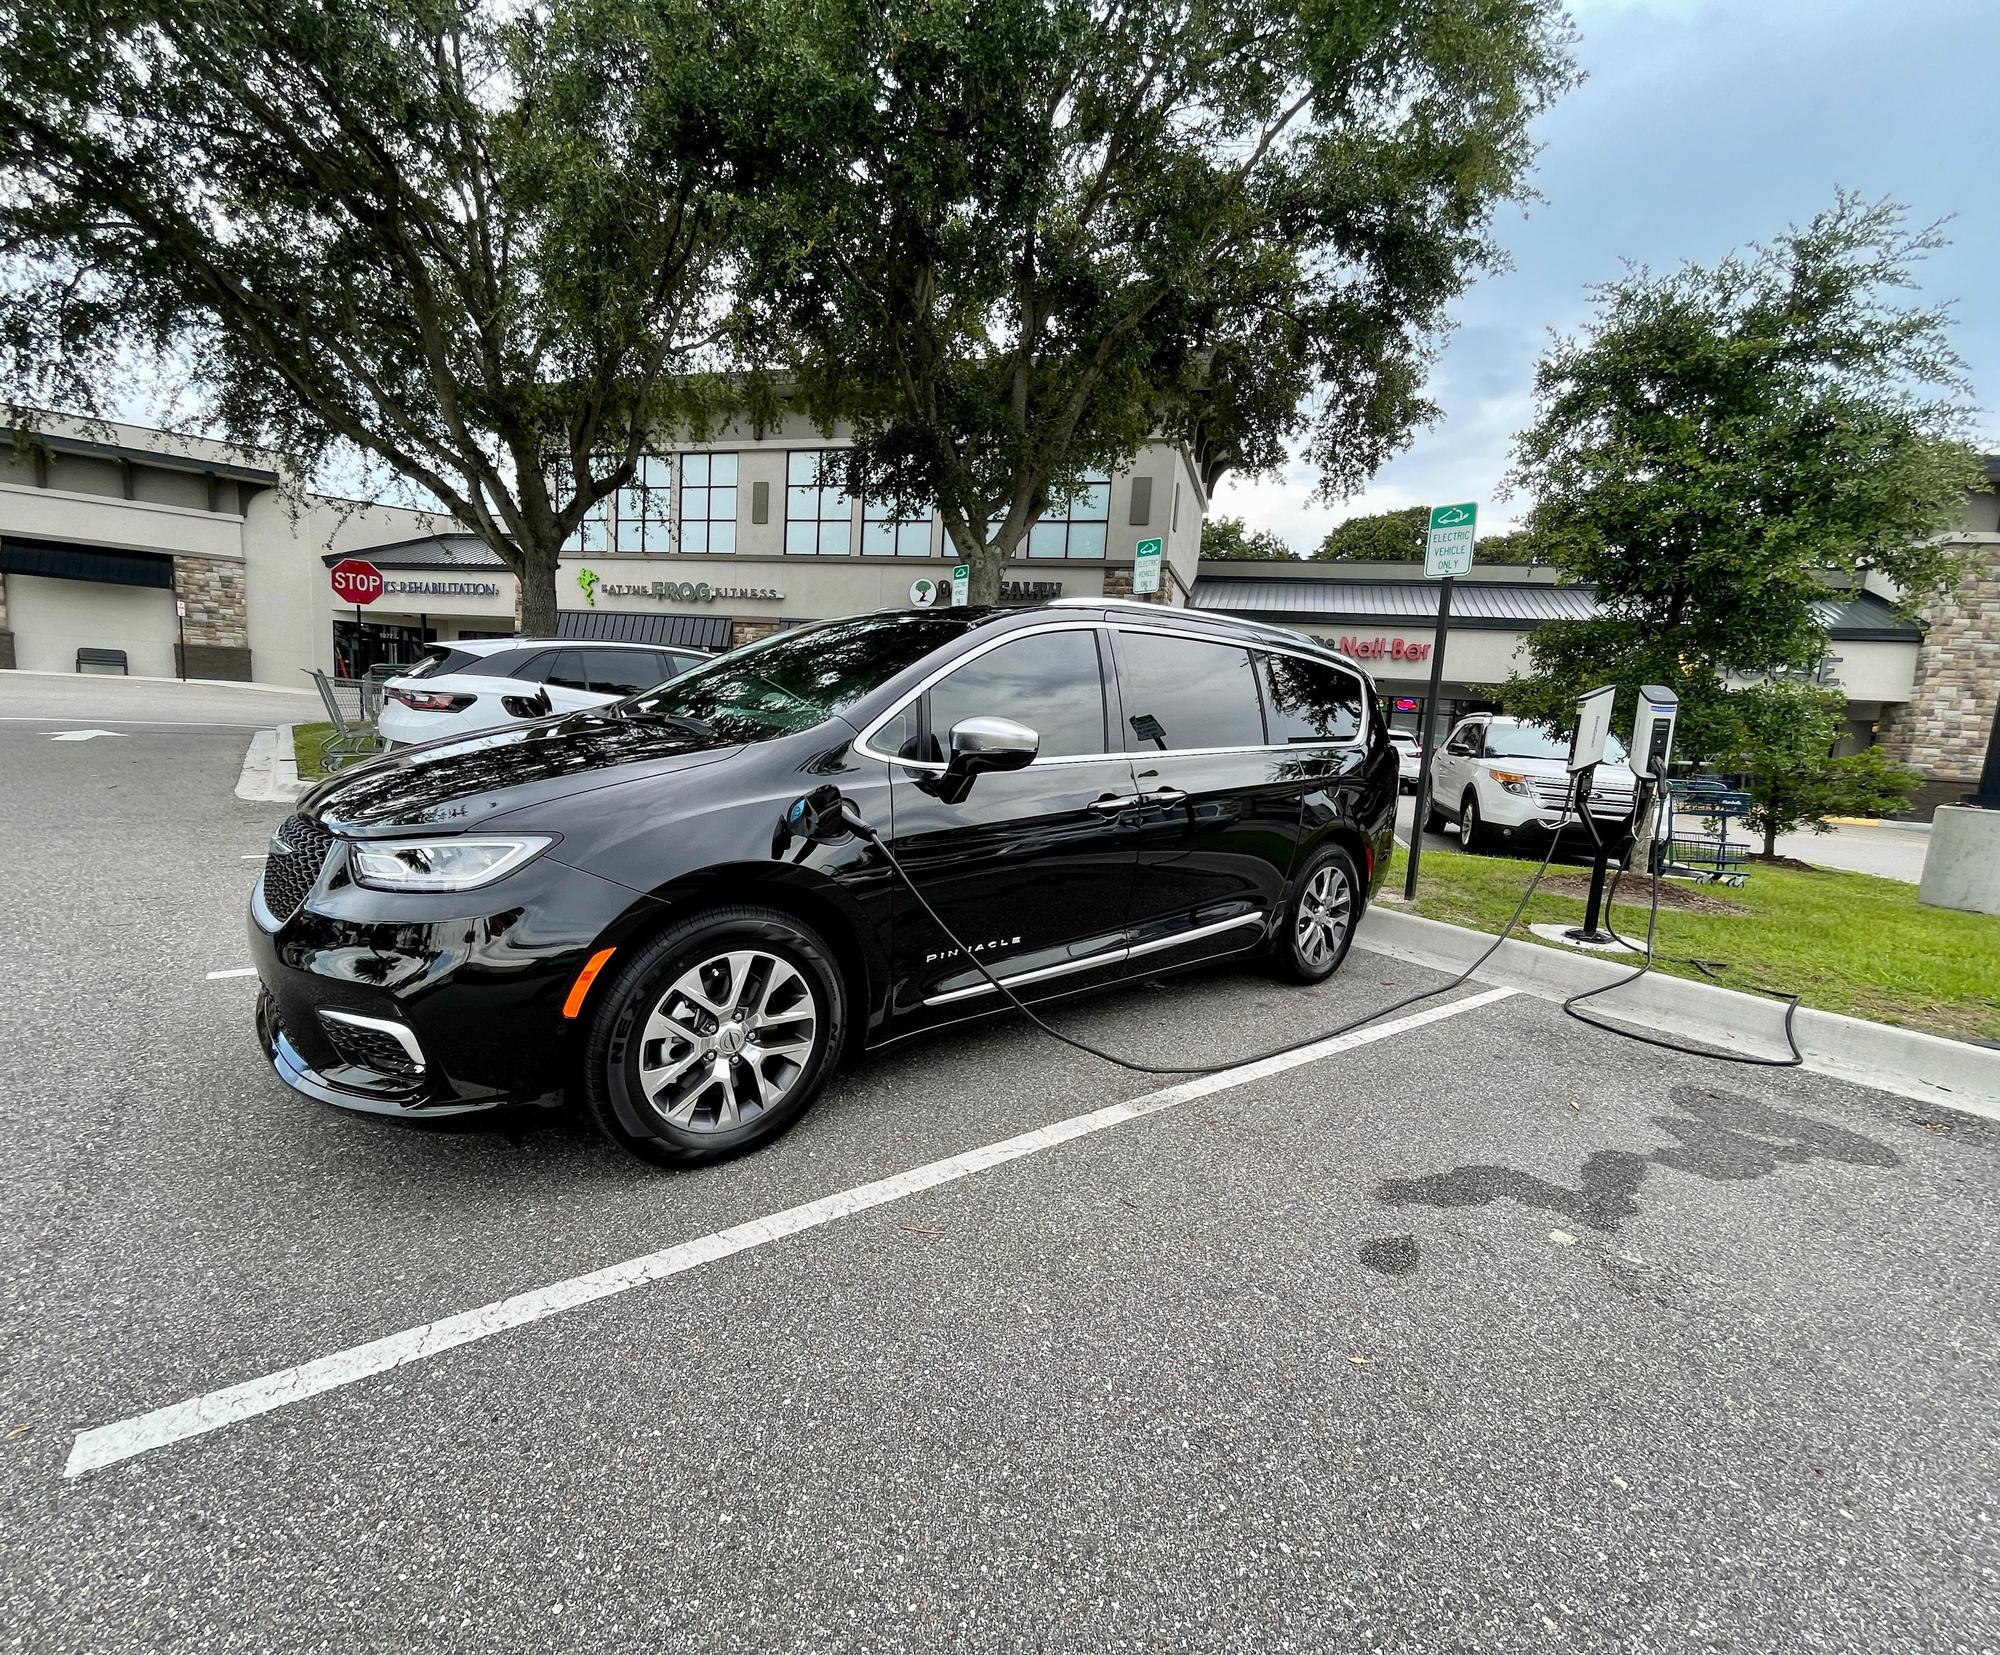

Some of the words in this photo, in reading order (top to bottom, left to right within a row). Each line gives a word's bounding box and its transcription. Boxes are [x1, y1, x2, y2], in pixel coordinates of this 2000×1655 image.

[1433, 531, 1470, 543] ELECTRIC
[1434, 545, 1466, 557] VEHICLE
[1438, 560, 1459, 570] ONLY
[334, 572, 381, 592] STOP
[601, 584, 622, 595] EAT
[625, 585, 649, 597] THE
[652, 581, 711, 601] FROG
[715, 587, 778, 600] FITNESS
[1000, 581, 1063, 600] EALTH
[1340, 636, 1386, 658] Nail
[1391, 638, 1432, 661] Bar
